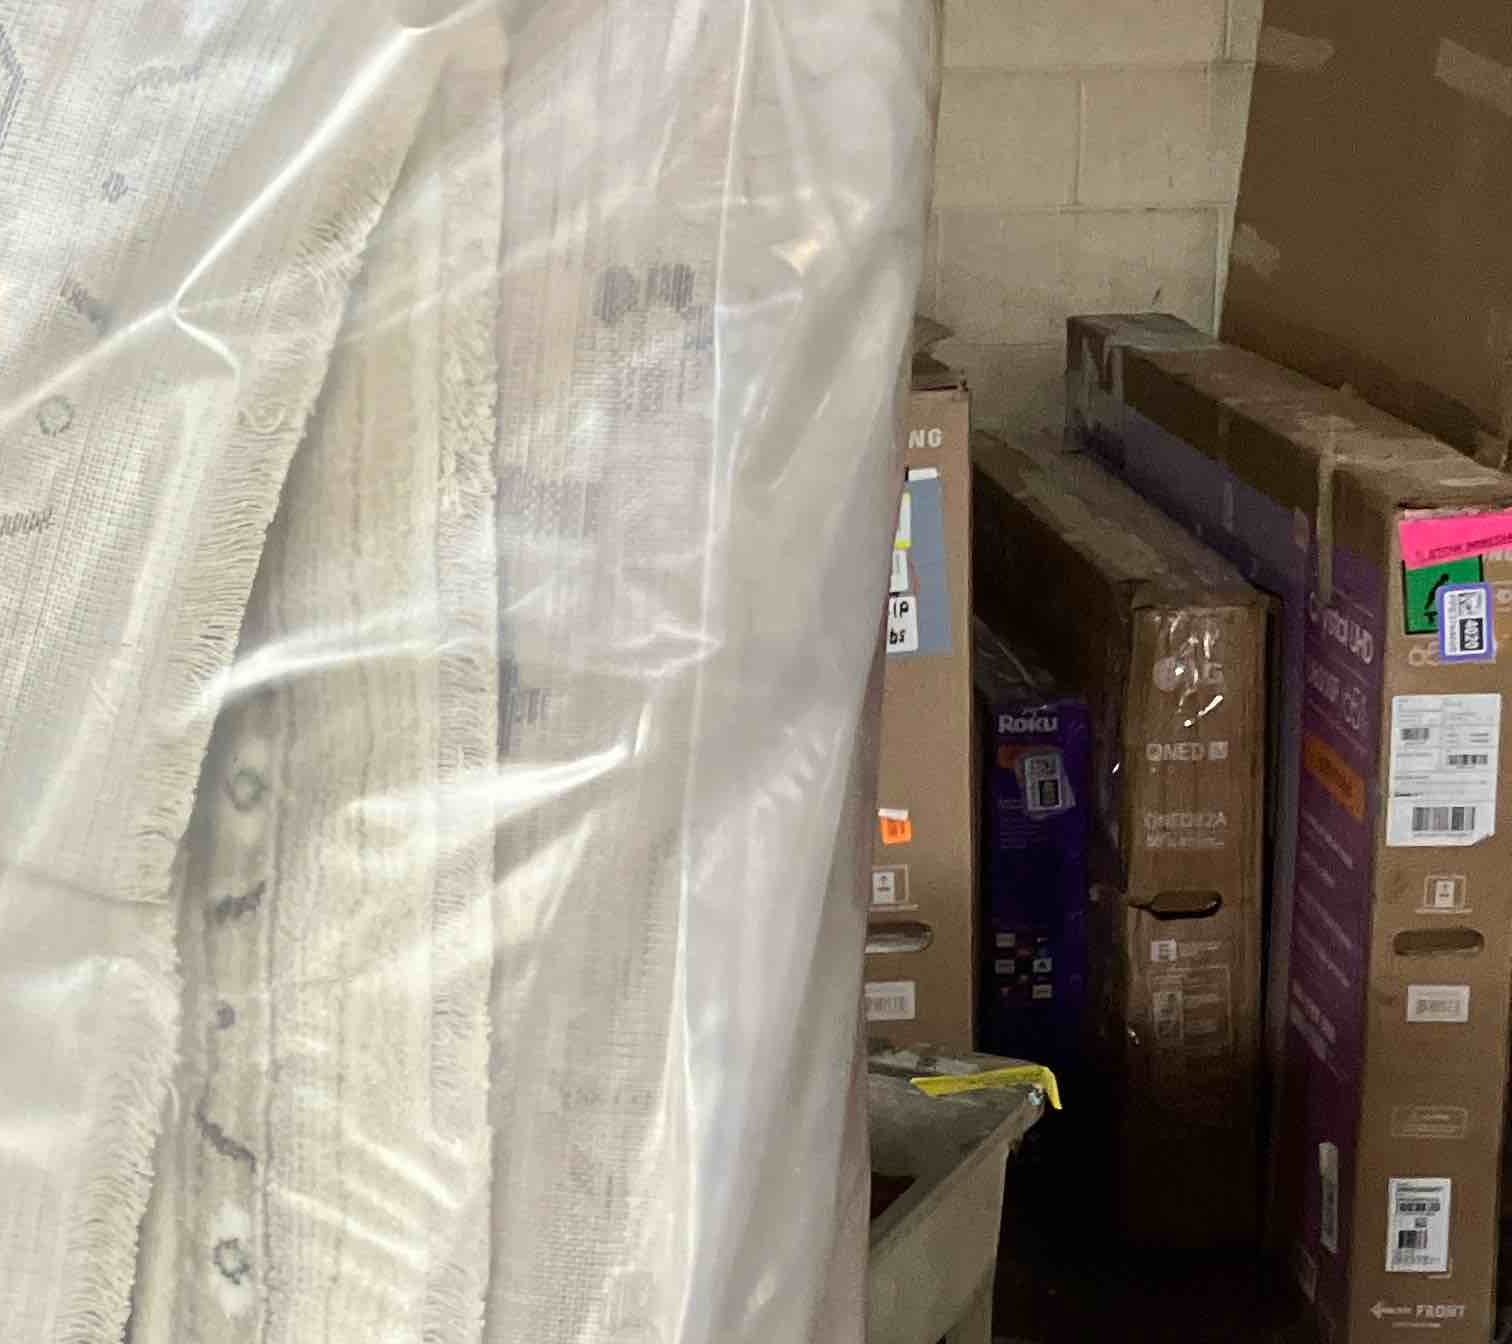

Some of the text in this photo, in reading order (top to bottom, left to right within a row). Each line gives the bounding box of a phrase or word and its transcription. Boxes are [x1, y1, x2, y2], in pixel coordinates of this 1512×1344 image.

[907, 428, 943, 449] NG
[998, 712, 1059, 734] Roku
[1415, 1304, 1465, 1320] FRONT
